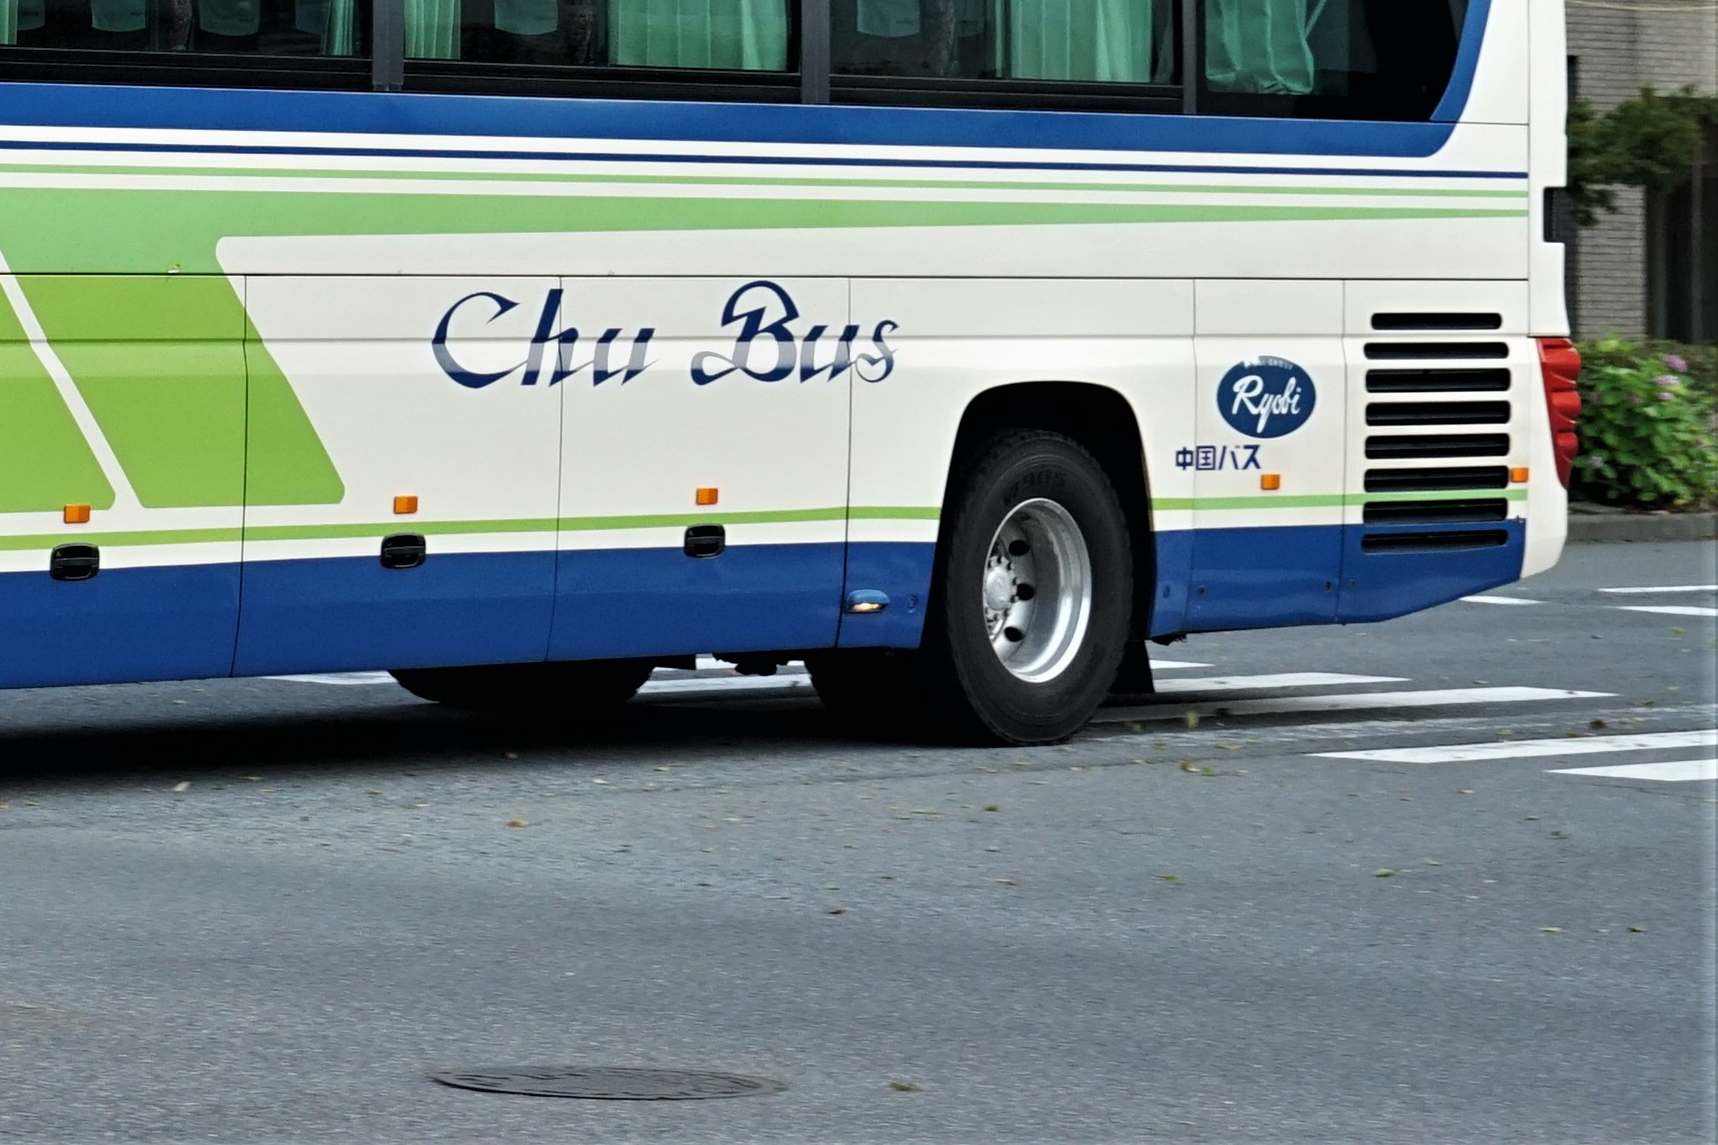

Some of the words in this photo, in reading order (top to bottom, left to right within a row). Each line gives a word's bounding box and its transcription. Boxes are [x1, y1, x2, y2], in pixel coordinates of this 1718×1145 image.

[431, 288, 659, 389] Chu
[690, 280, 899, 385] Bus
[1232, 374, 1302, 434] Ryobi
[1175, 445, 1262, 471] 中国バス
